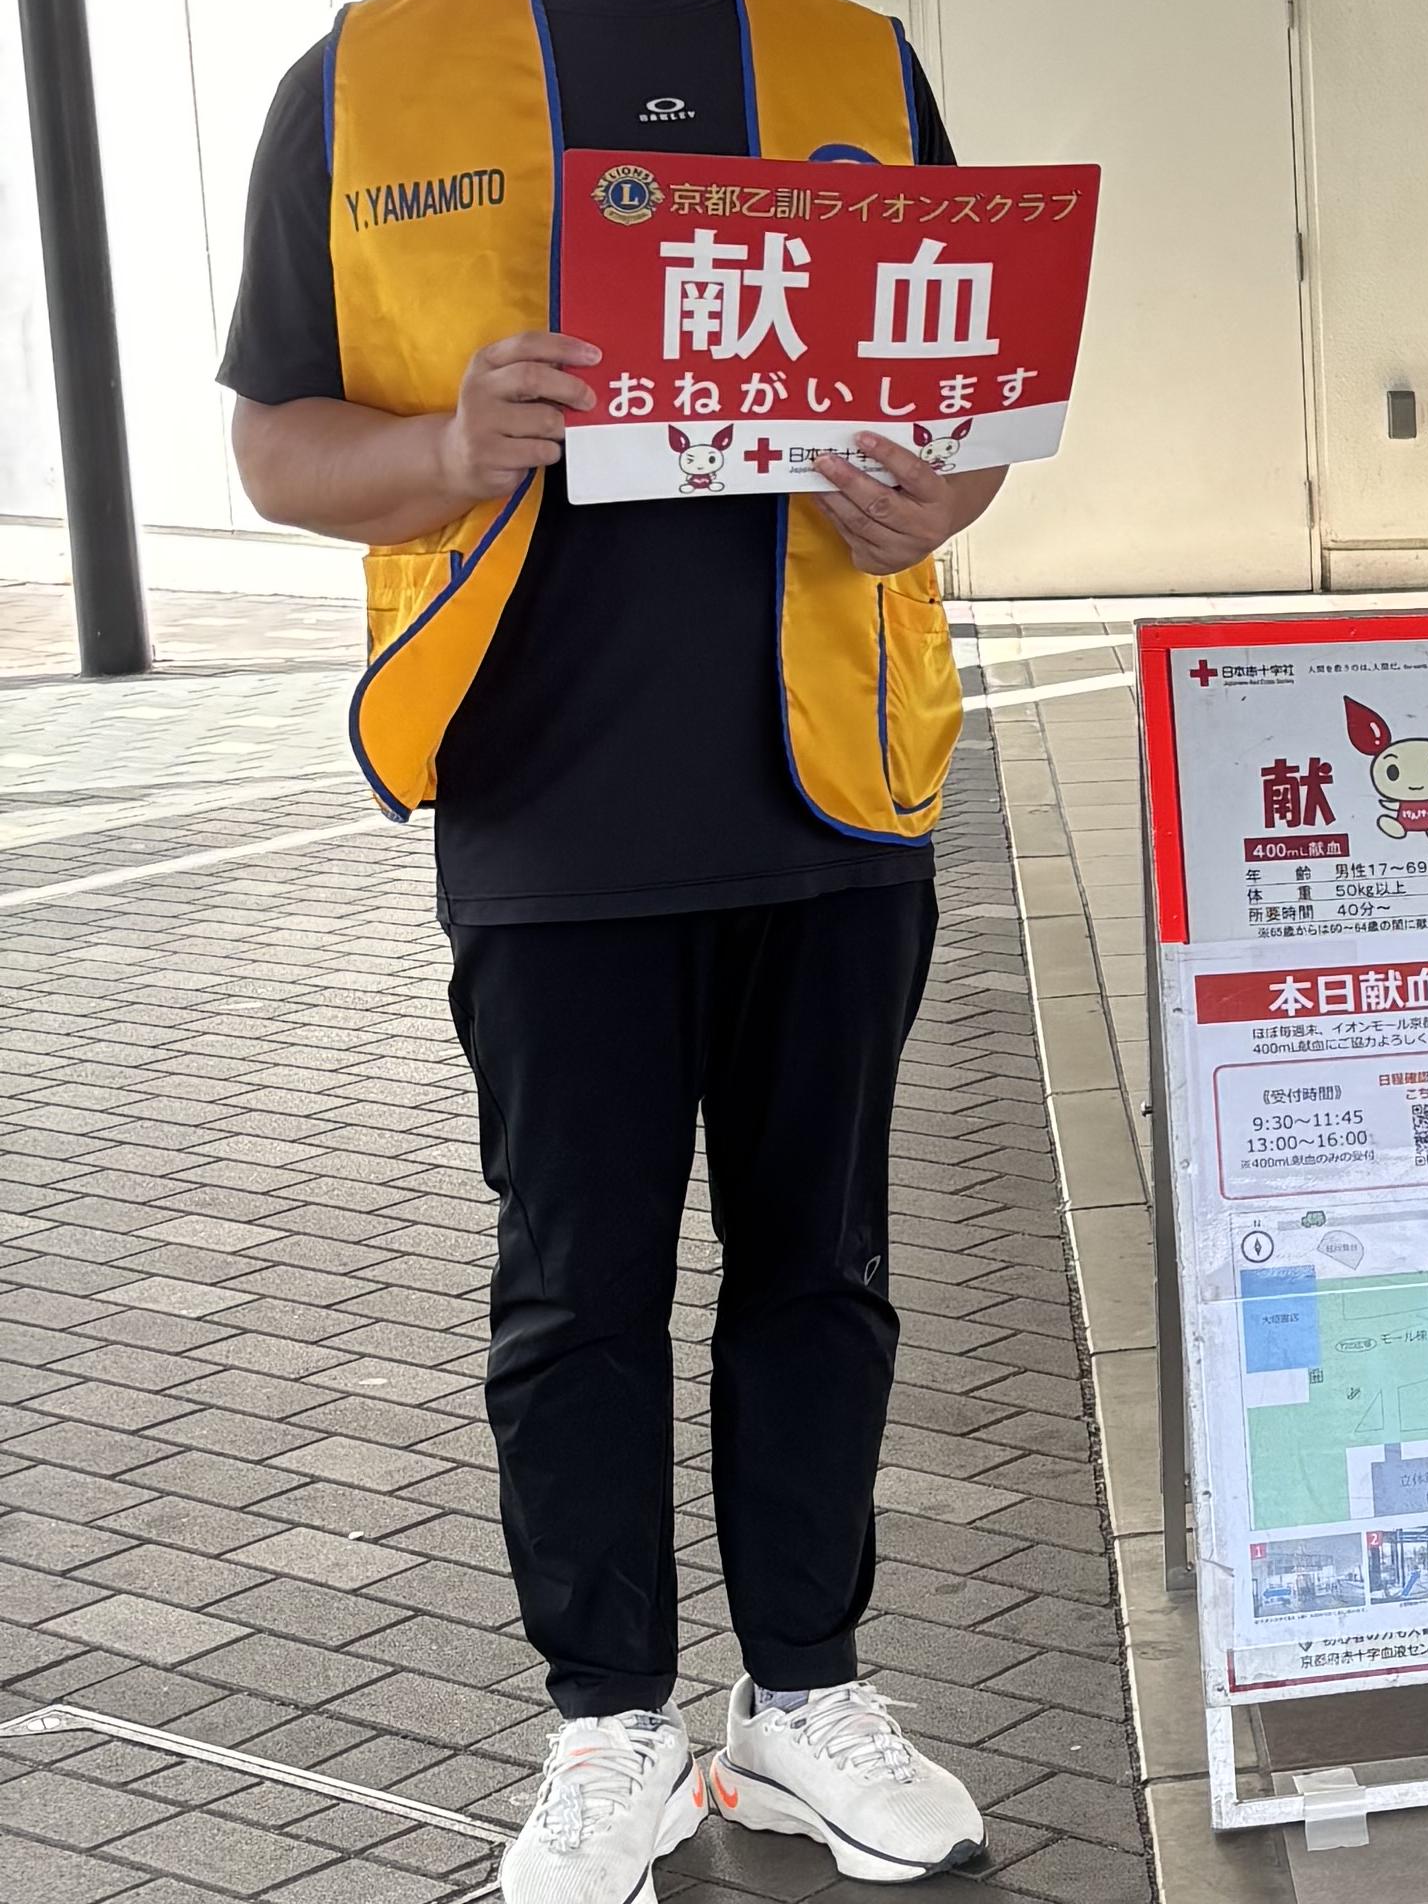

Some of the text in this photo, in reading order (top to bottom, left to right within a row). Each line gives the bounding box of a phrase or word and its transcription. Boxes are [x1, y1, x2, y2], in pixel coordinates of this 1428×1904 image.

[609, 165, 650, 181] LIONS
[345, 168, 506, 233] Y.YAMAMOTO
[621, 183, 639, 206] L
[669, 182, 1083, 224] 京都乙訓ライオンズクラブ
[608, 367, 1039, 419] おねがいします
[1252, 840, 1342, 858] 400mL献血
[1335, 882, 1407, 898] 50kg以上
[1248, 904, 1314, 923] 所要時間
[1252, 1109, 1364, 1132] 9:30～11:45
[1247, 1130, 1368, 1153] 13:00～16:00
[1370, 1534, 1379, 1546] 2
